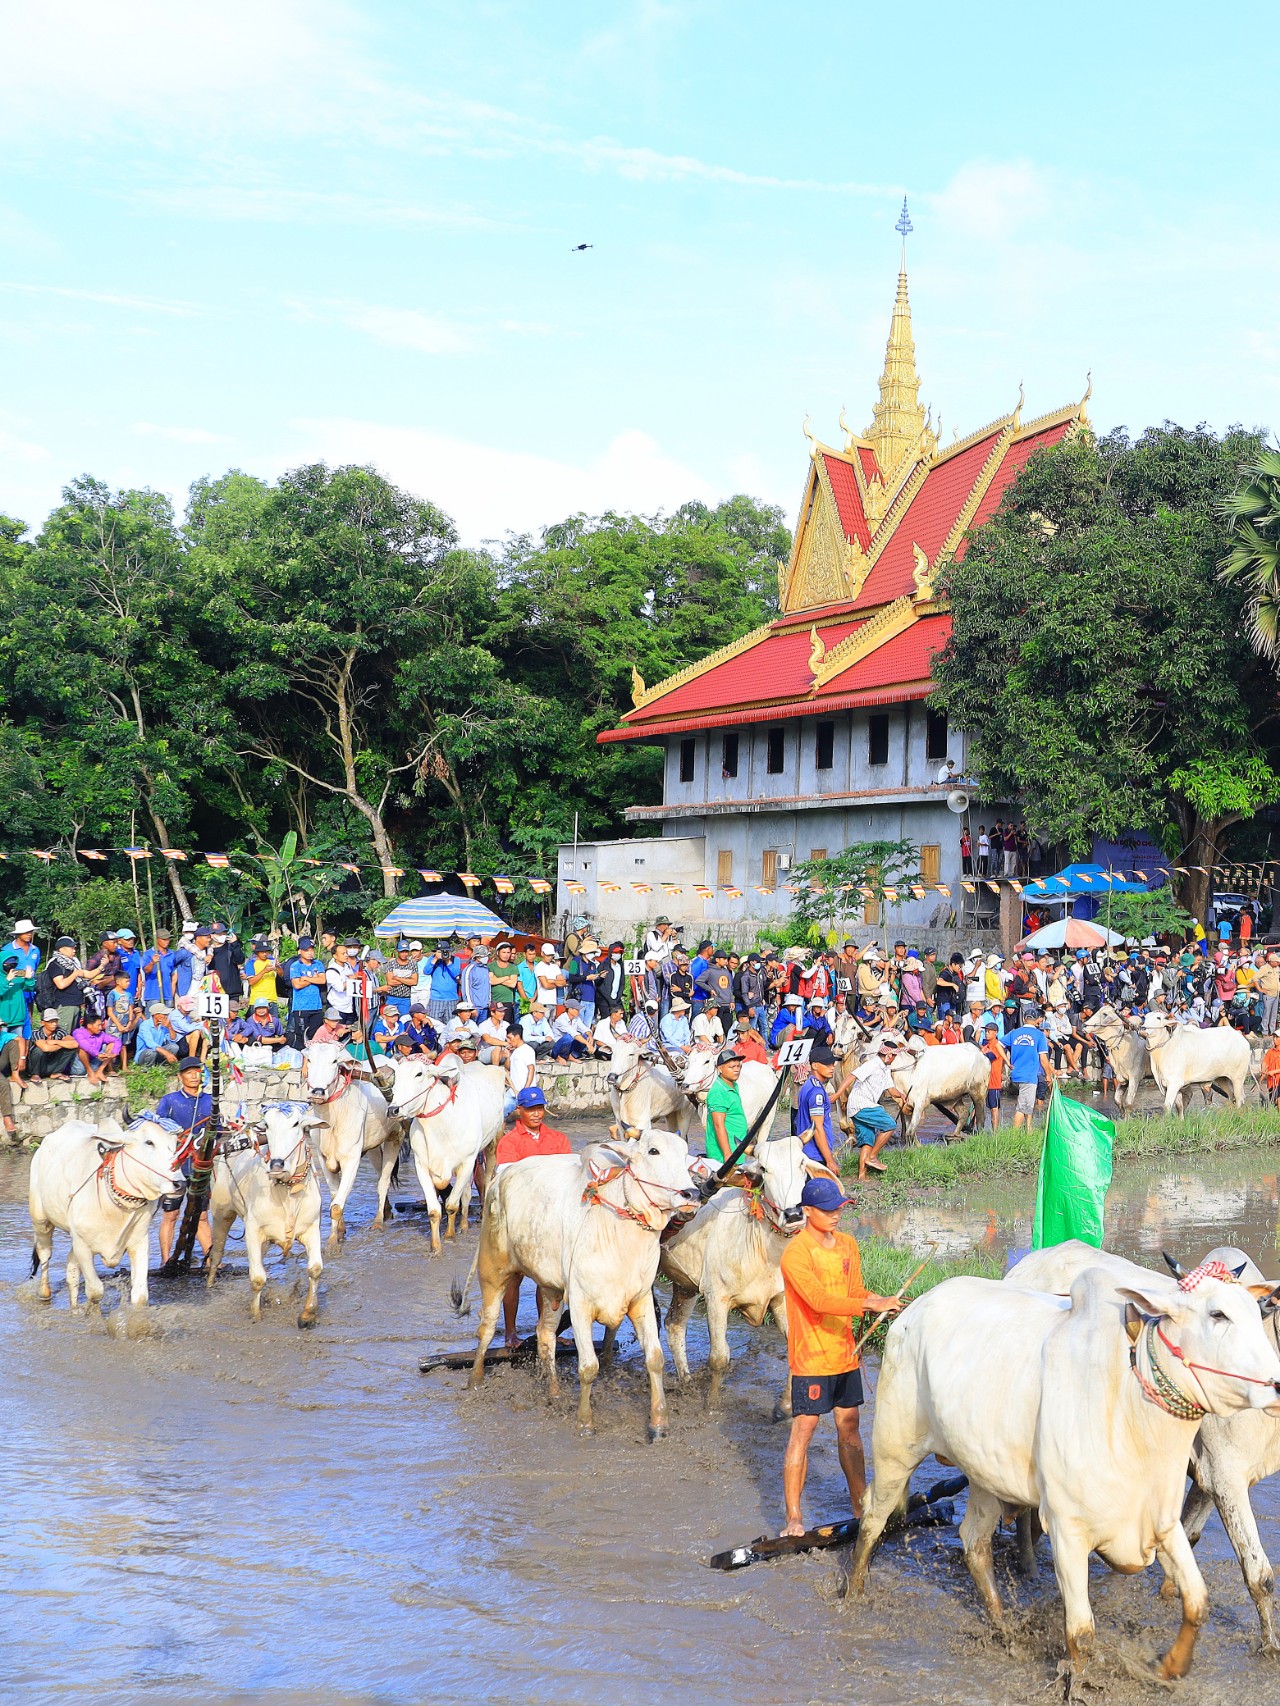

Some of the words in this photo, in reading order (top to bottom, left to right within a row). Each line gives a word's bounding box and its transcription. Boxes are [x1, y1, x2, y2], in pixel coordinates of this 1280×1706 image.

[628, 962, 641, 973] 25
[206, 996, 222, 1015] 15
[783, 1042, 804, 1062] 14
